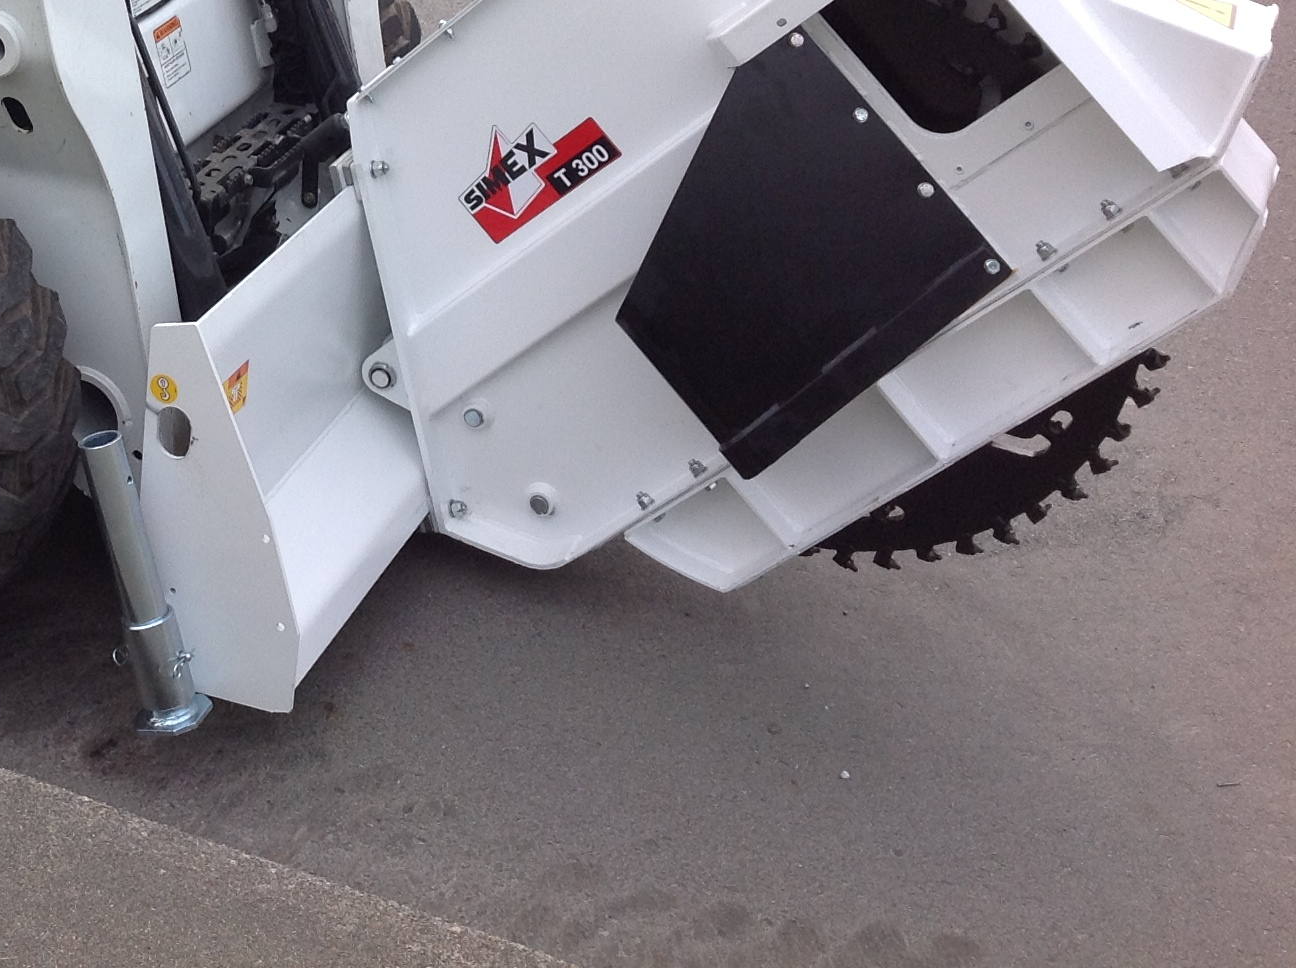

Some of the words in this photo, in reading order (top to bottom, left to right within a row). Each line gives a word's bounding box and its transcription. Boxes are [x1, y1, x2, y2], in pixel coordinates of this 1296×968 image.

[463, 127, 551, 211] SIMEX
[553, 167, 572, 188] T
[572, 144, 610, 178] 300
